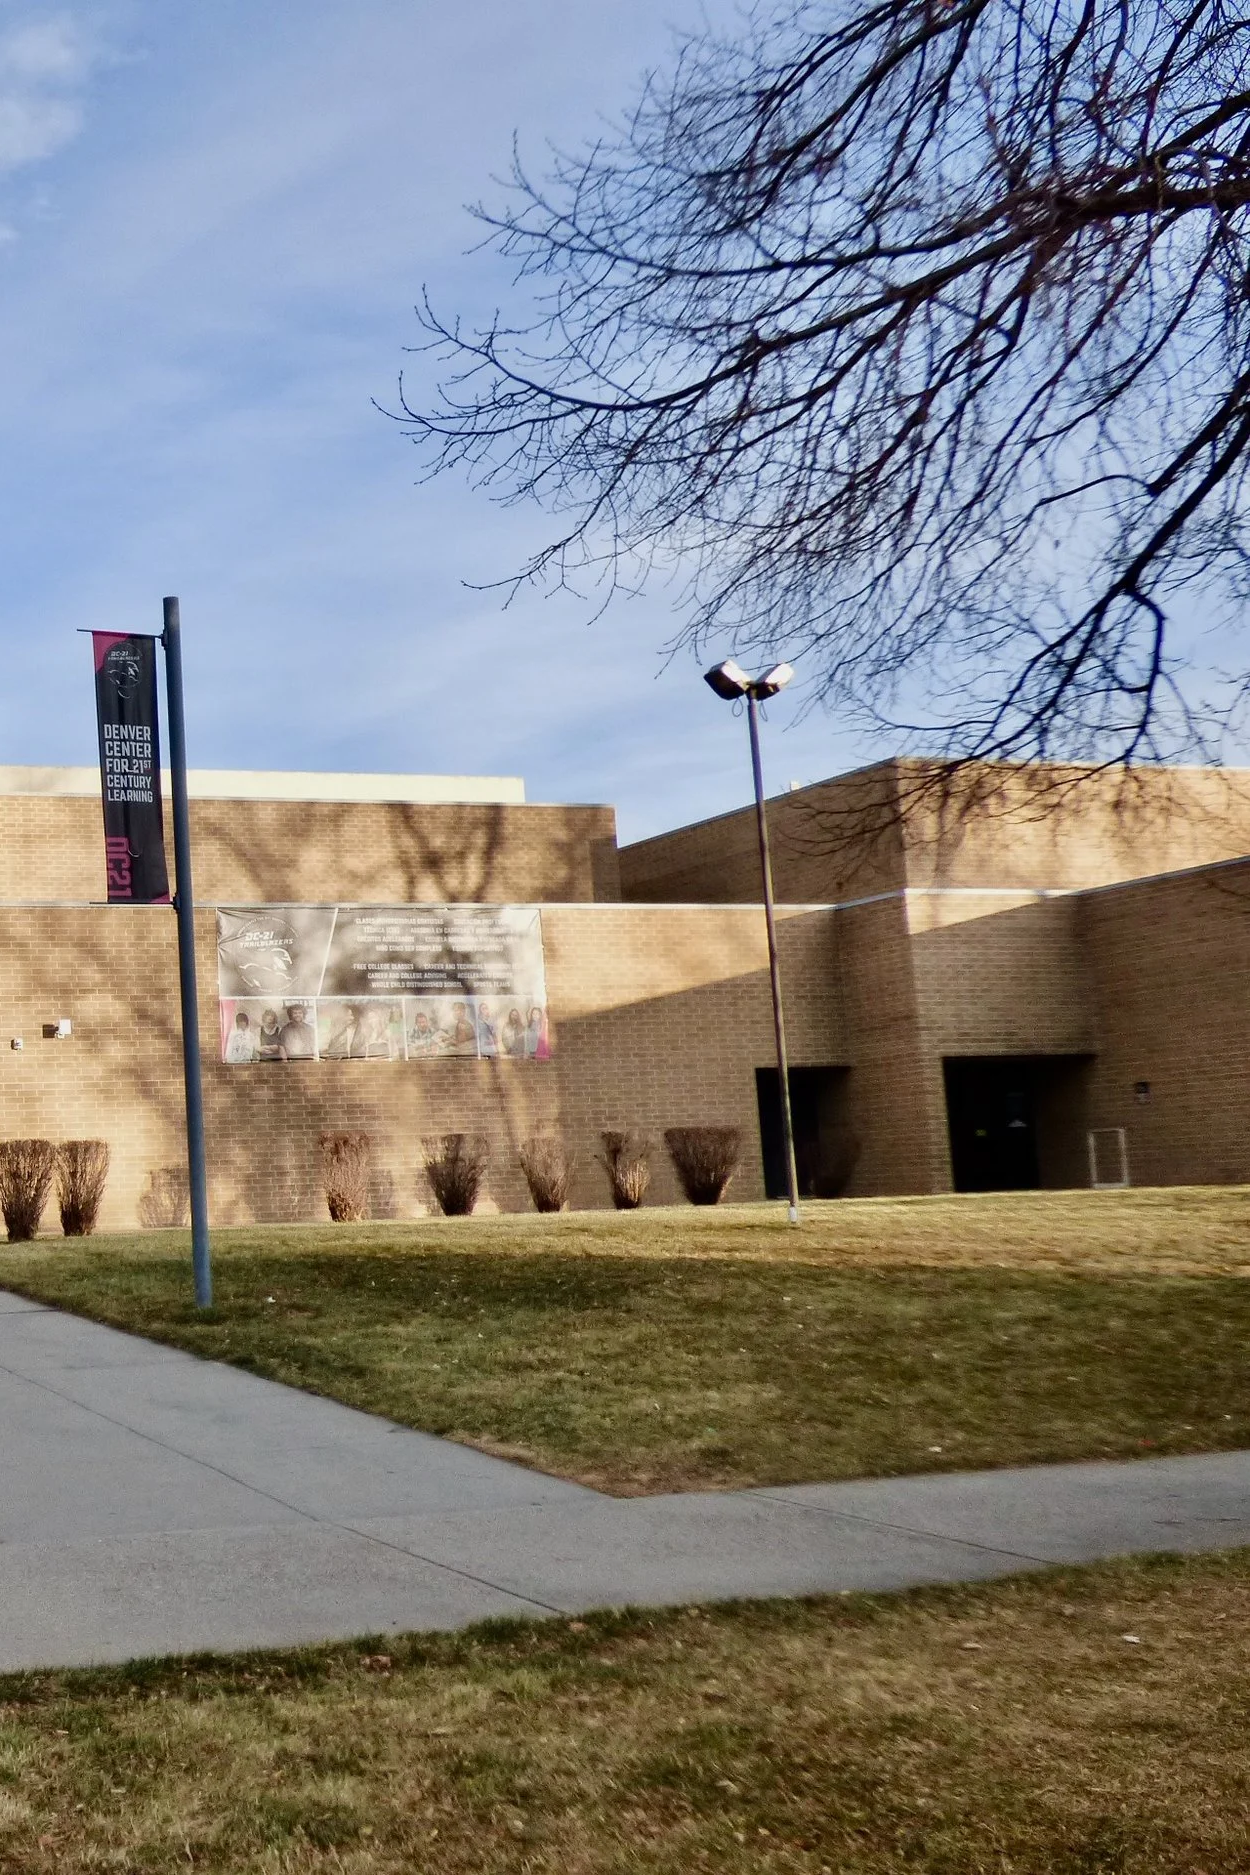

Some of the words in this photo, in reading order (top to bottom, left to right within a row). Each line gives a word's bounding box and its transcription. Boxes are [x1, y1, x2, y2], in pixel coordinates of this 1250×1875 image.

[104, 724, 151, 741] DENVER
[105, 741, 152, 758] CENTER
[106, 758, 129, 773] FOR
[107, 774, 152, 789] CENTURY
[108, 789, 153, 803] LEARNING
[245, 931, 275, 941] DC-21
